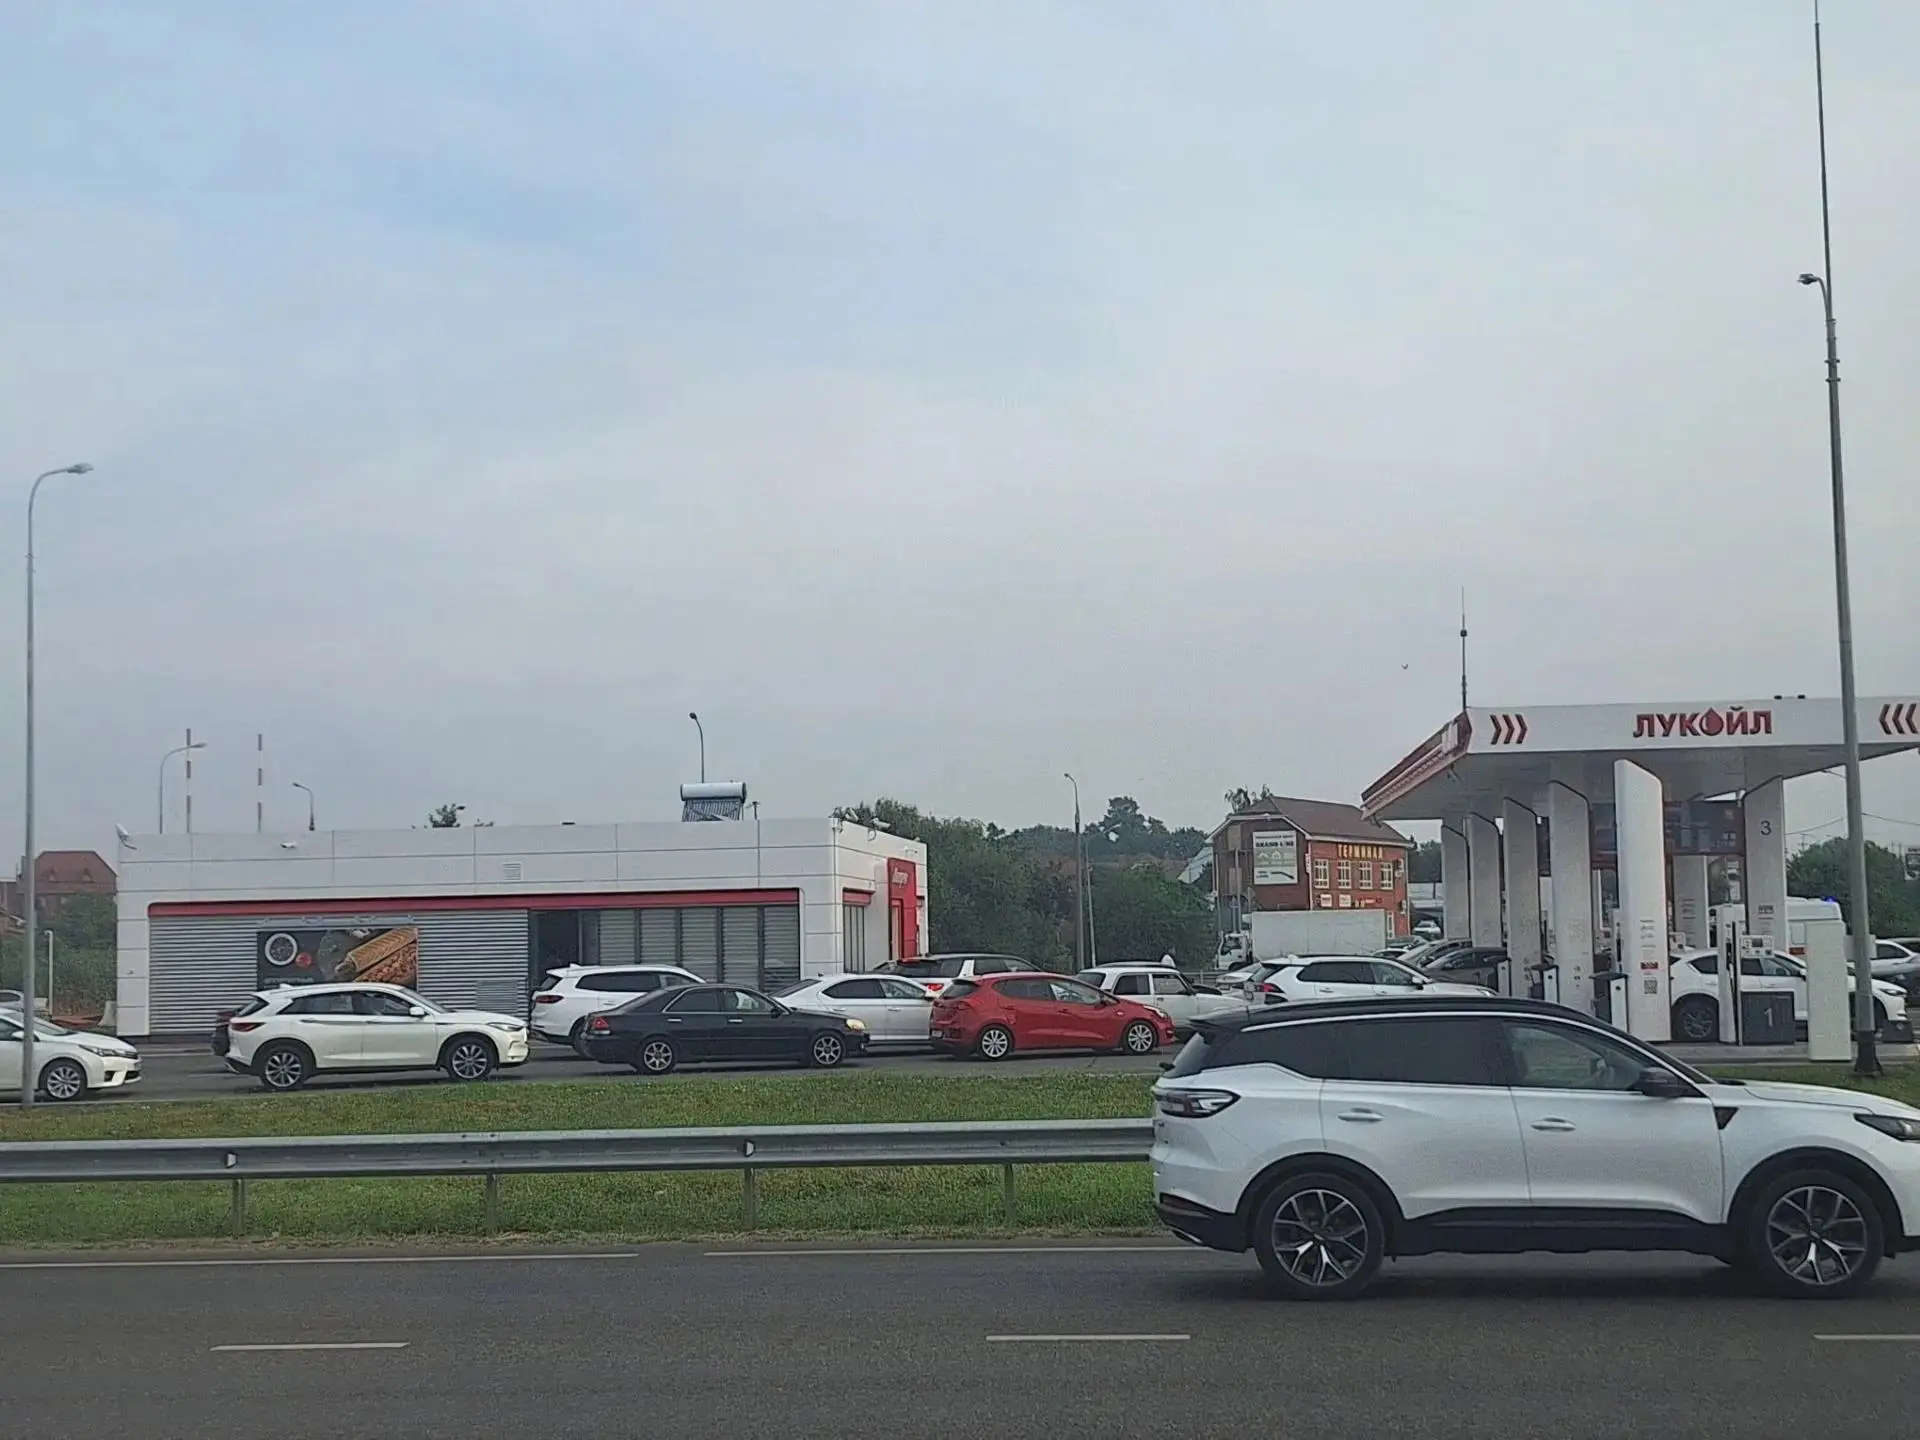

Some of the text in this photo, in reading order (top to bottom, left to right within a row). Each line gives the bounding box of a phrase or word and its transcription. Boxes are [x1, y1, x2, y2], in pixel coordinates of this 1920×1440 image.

[1633, 706, 1772, 738] ЛУКОЙЛ
[1760, 820, 1772, 836] 3
[1764, 1007, 1773, 1028] 1
